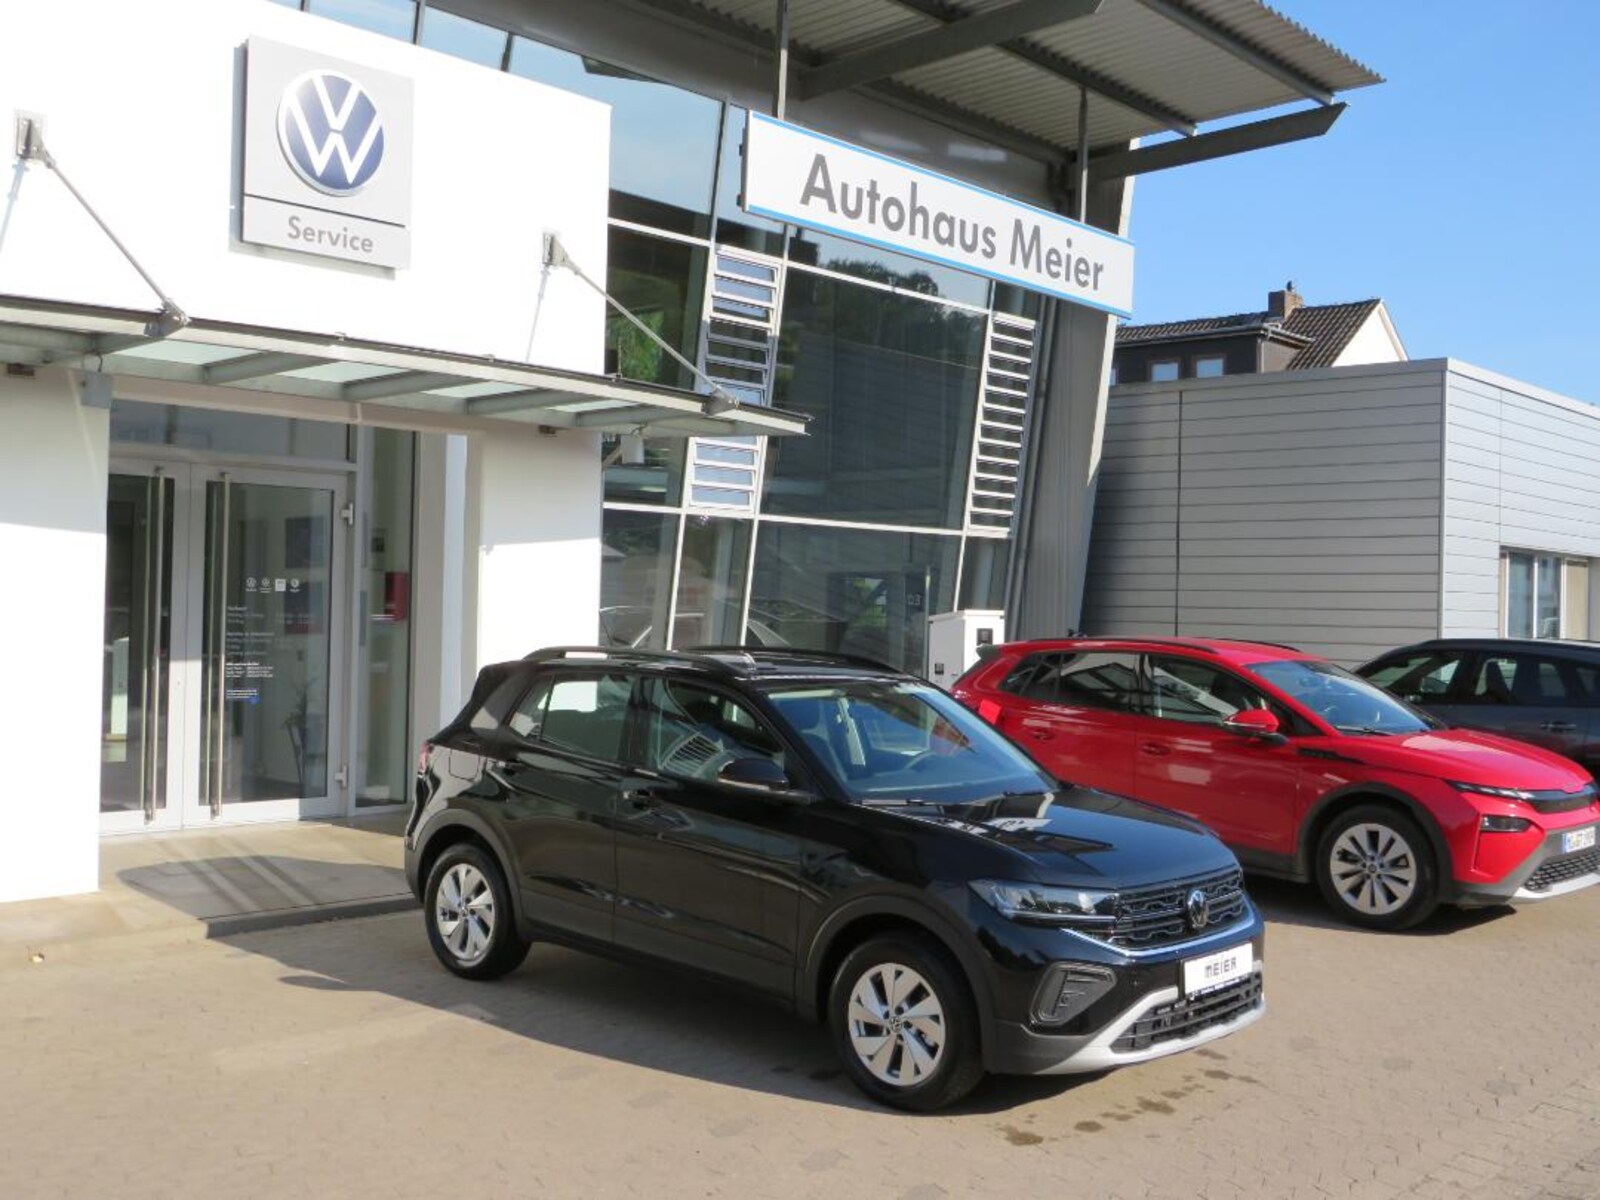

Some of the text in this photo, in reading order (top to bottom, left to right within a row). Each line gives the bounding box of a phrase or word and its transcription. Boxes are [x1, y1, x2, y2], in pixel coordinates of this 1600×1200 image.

[287, 215, 374, 253] Service
[800, 153, 1105, 291] Autohaus Meier
